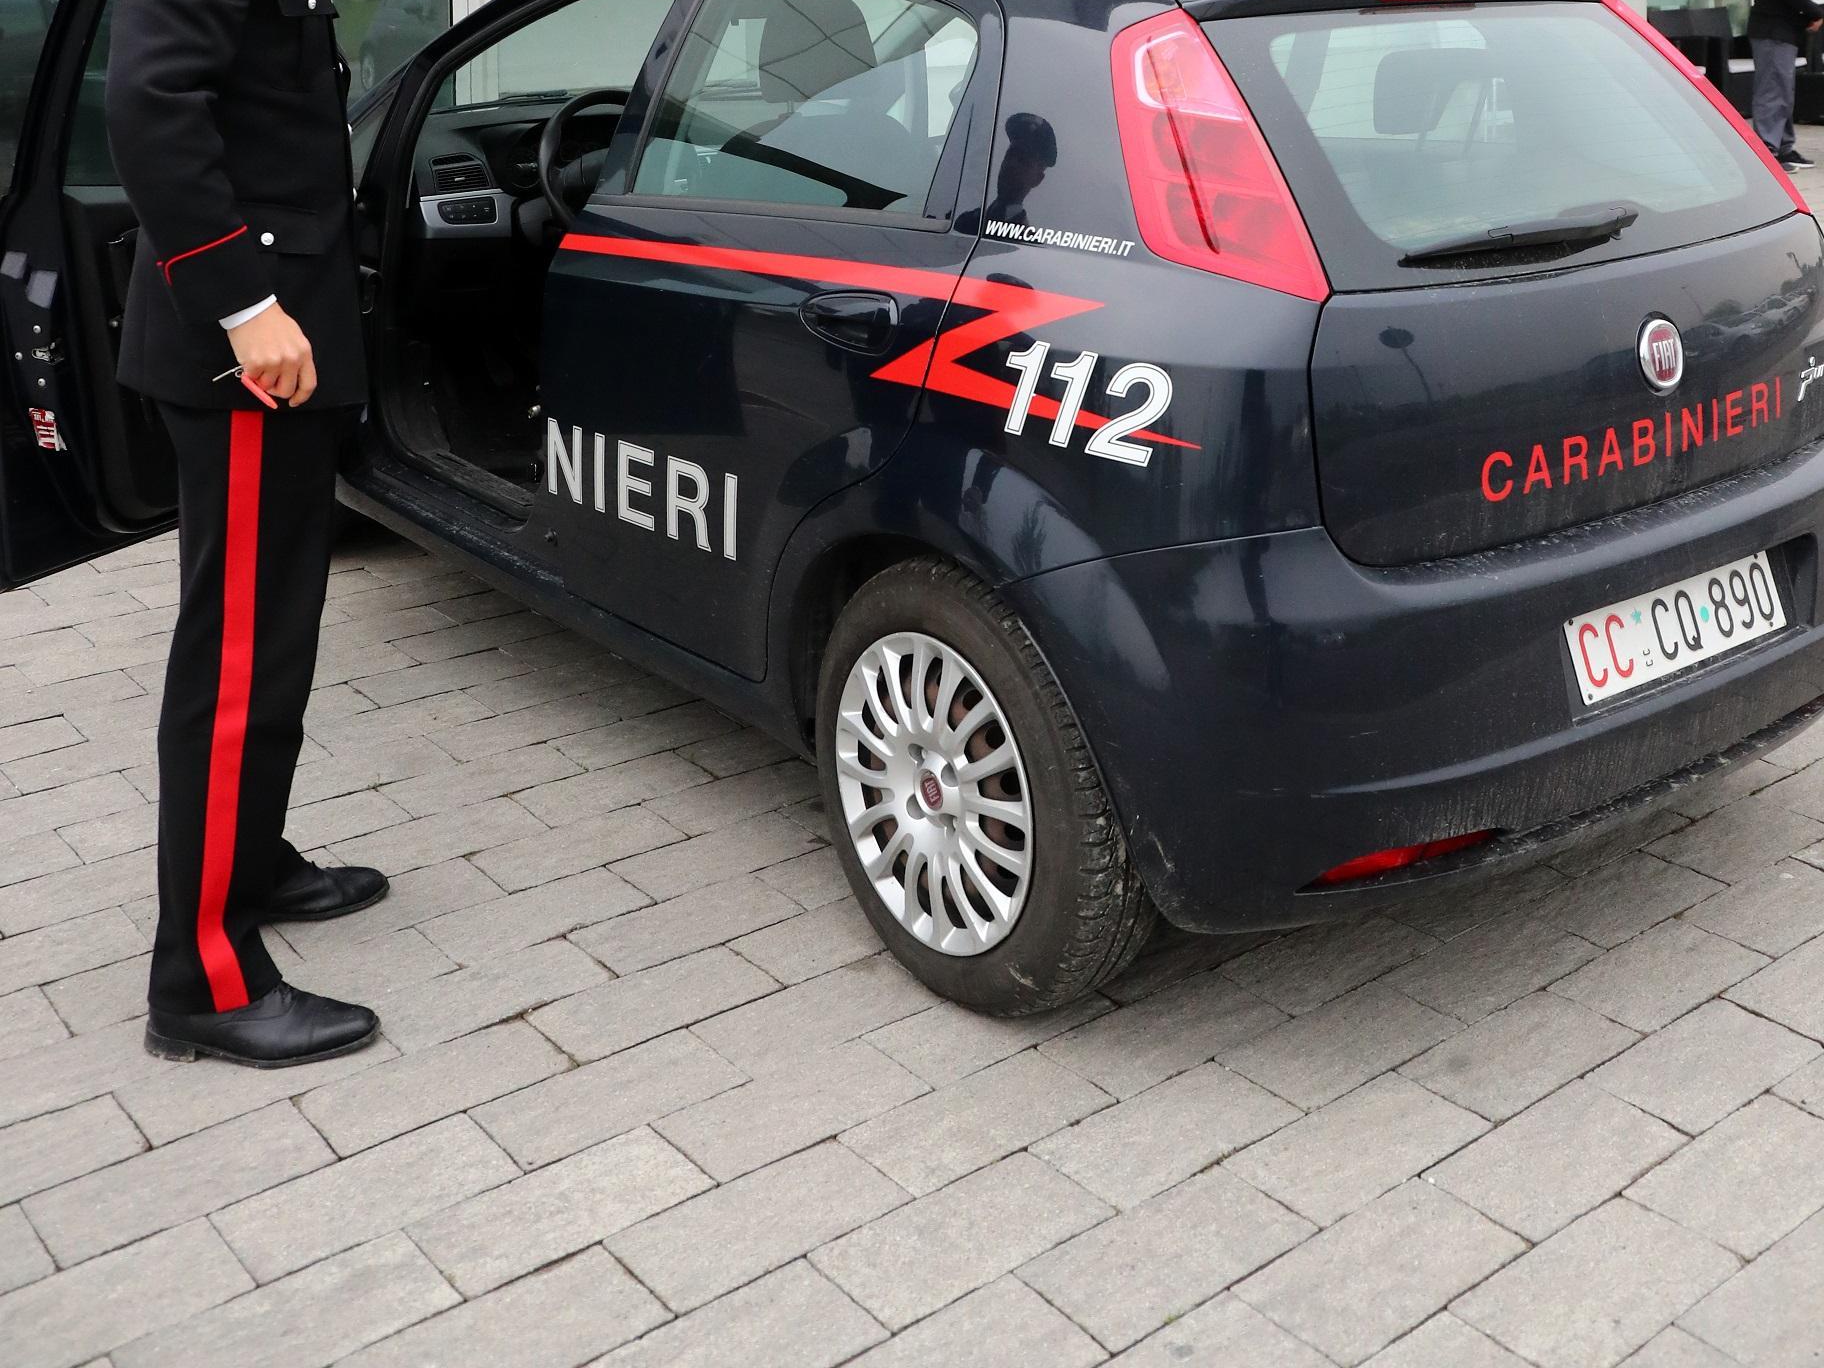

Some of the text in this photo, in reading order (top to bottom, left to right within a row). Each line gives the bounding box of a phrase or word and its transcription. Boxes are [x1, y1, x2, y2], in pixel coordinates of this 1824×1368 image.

[985, 219, 1136, 257] WWW.CARABINIERI.IT
[1003, 340, 1174, 468] 112
[1652, 339, 1678, 372] FIAT
[547, 416, 738, 562] NIERI
[1480, 376, 1783, 503] CARABINIERI
[1577, 561, 1776, 688] CC CQ 890
